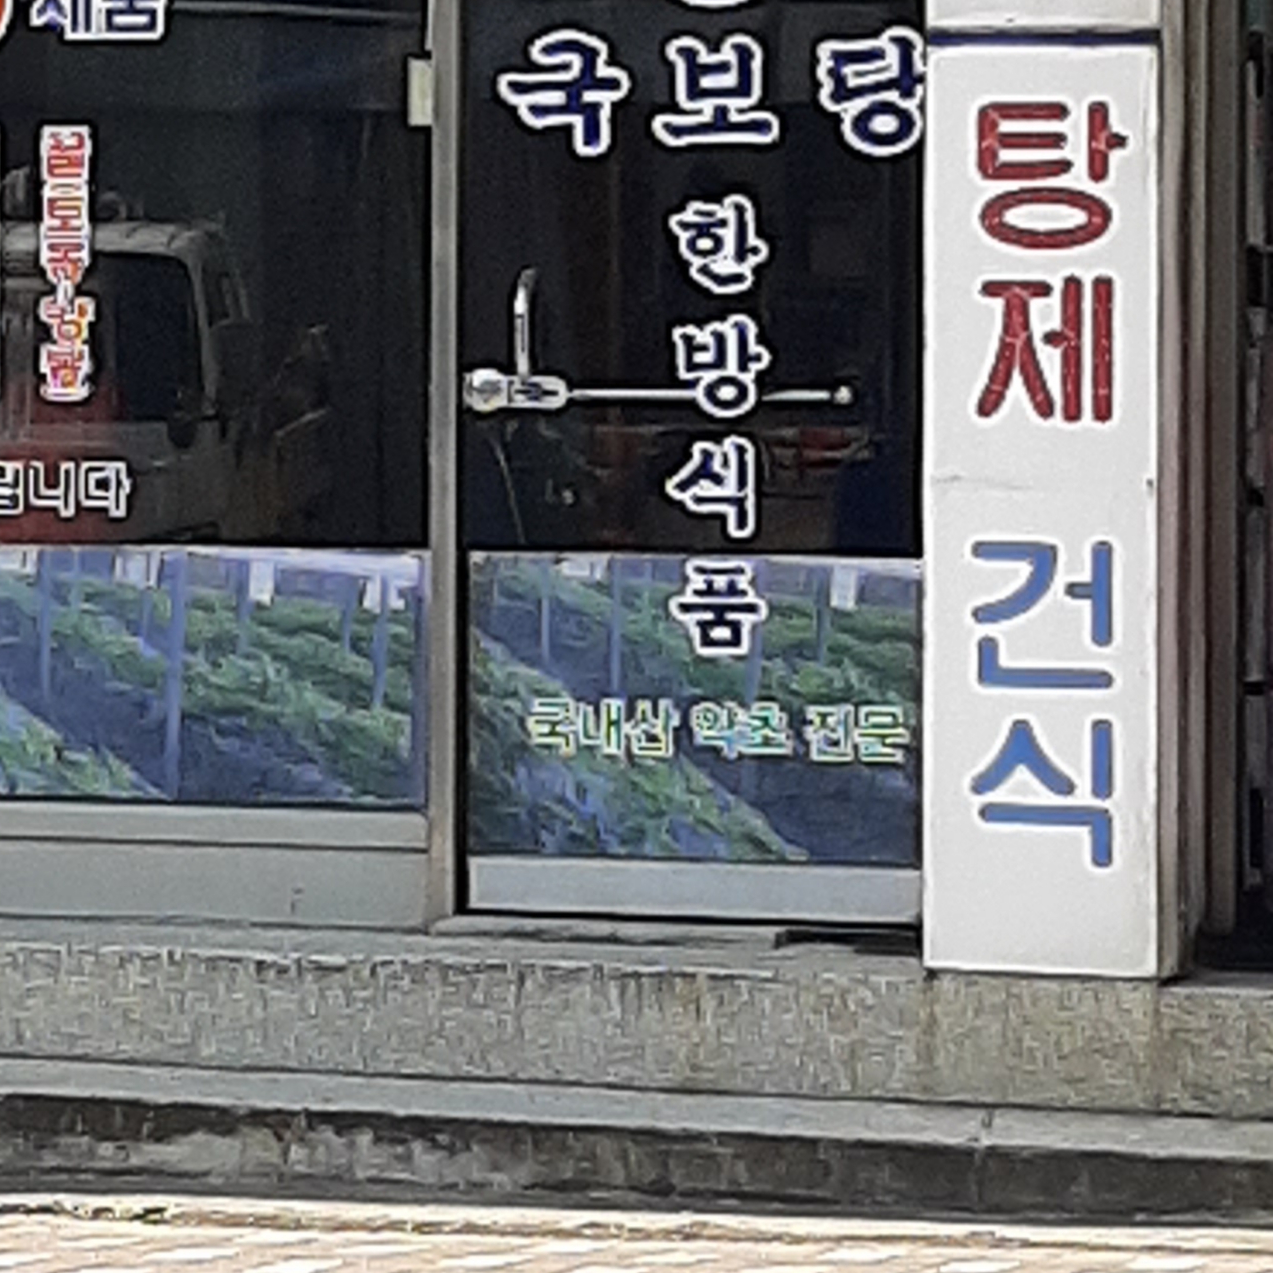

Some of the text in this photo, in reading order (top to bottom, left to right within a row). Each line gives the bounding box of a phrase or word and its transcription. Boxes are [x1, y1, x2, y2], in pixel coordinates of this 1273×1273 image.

[497, 27, 924, 158] 국보당
[664, 193, 770, 657] 한방식품
[973, 99, 1128, 425] 탕제
[528, 695, 911, 764] 국내산 약초 전문
[970, 540, 1116, 870] 건식
